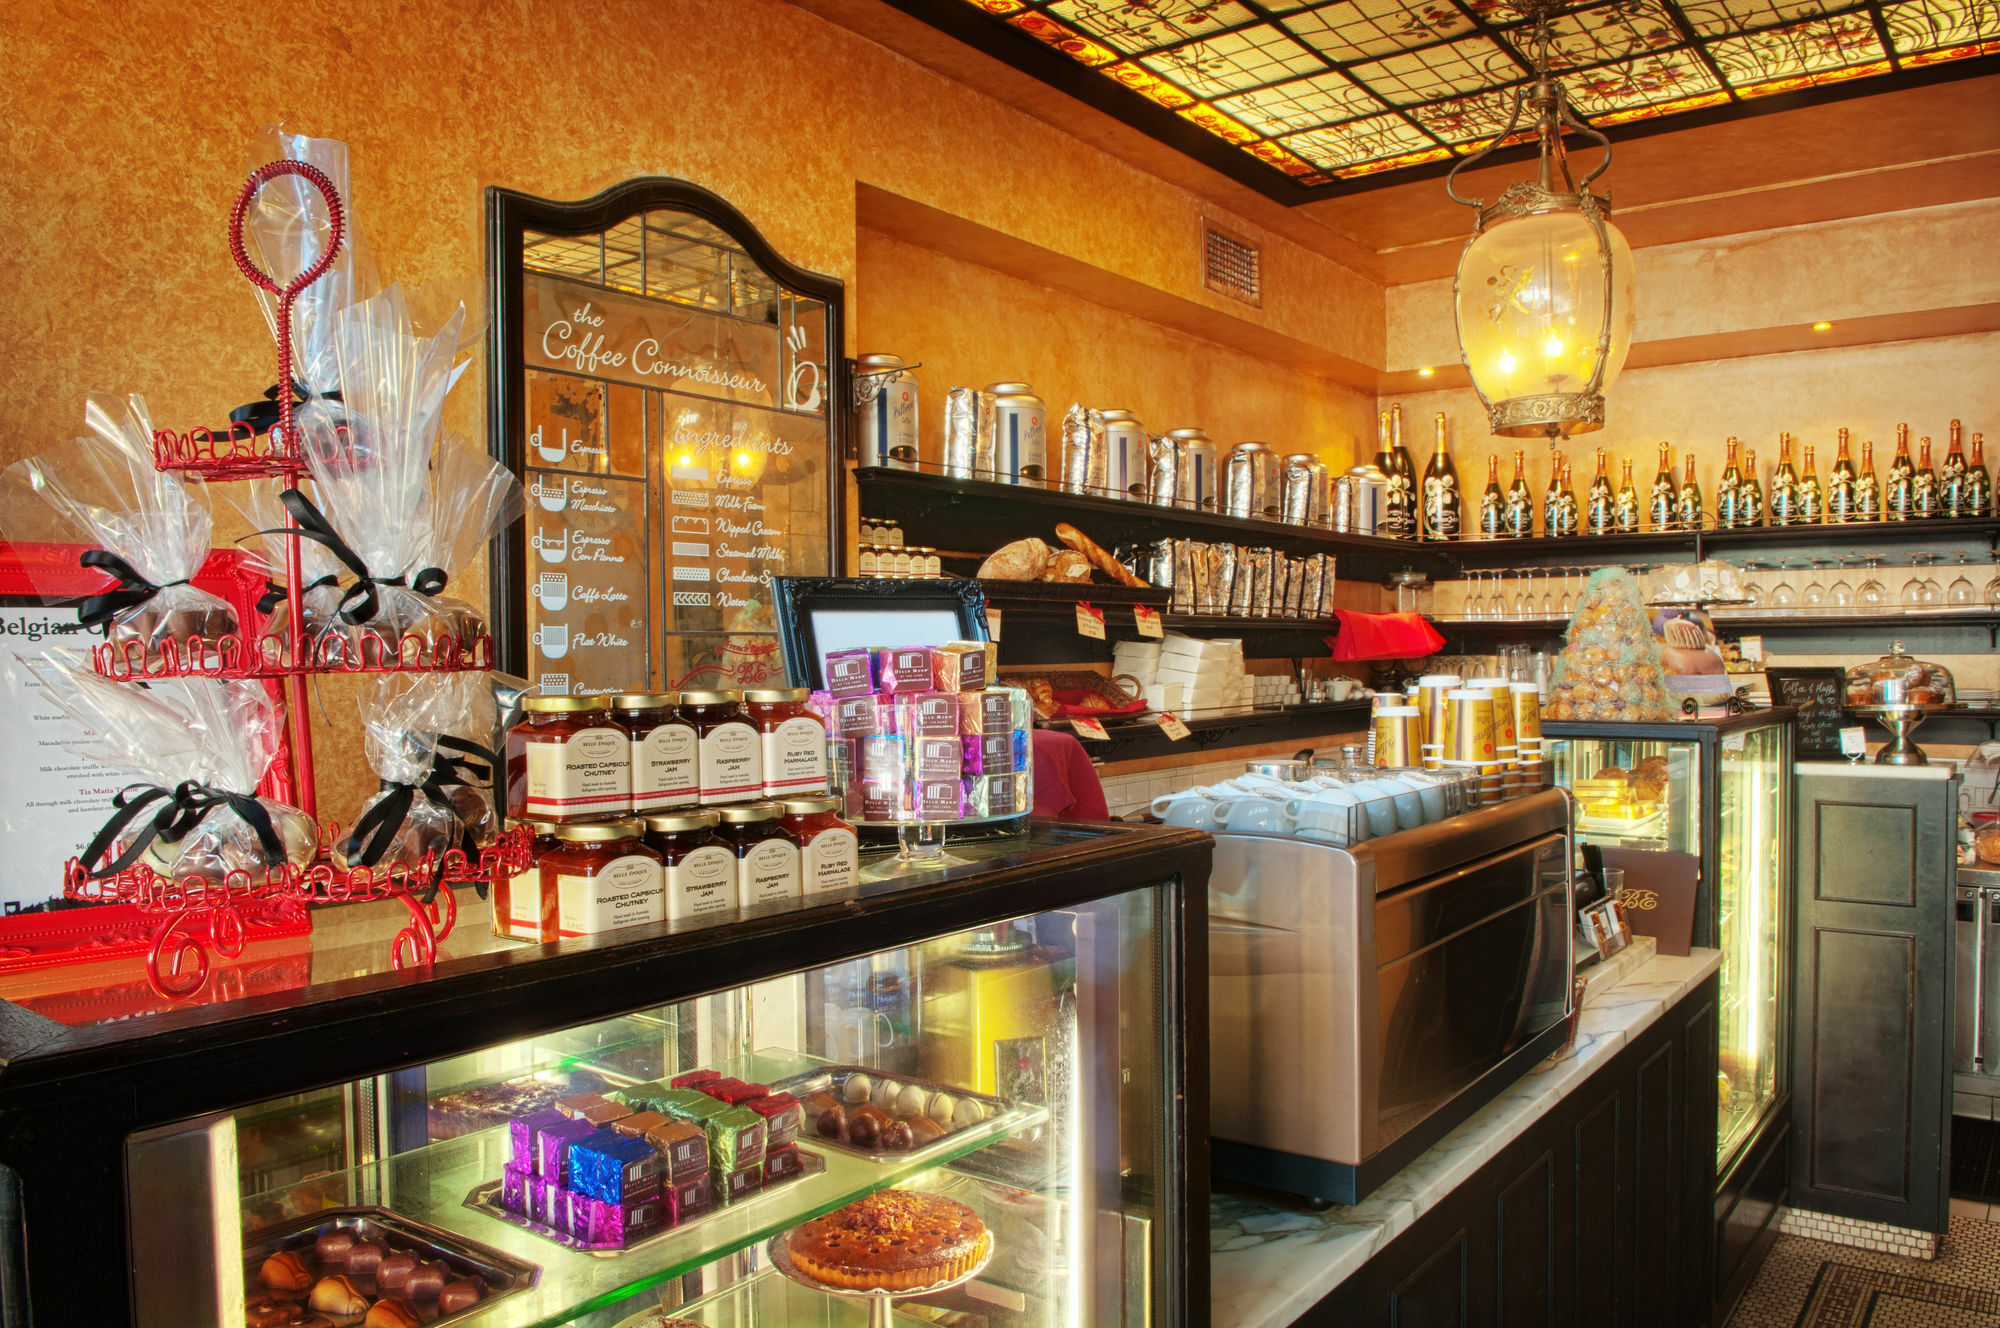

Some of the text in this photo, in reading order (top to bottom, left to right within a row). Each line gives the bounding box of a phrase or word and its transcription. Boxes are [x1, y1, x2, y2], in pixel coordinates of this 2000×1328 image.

[573, 302, 604, 327] the
[543, 320, 766, 392] Coffee Connoisseur
[674, 409, 793, 456] Ingredients
[571, 481, 608, 497] Espresso
[571, 500, 616, 513] Macchiato
[715, 494, 766, 512] Milk Foam
[716, 518, 781, 538] Wipped Cream
[571, 530, 611, 547] Espresso
[571, 547, 624, 562] Con Panna
[716, 543, 782, 561] Steamed Milk
[716, 567, 758, 583] Chocolate
[601, 586, 628, 602] Latte
[717, 592, 748, 607] Water
[572, 632, 629, 650] Flat White
[737, 661, 767, 684] BE
[566, 763, 597, 771] ROASTED
[651, 758, 691, 767] STRAWBERRY
[716, 757, 751, 765] RASPBERRY
[784, 756, 818, 764] MARMALADE
[584, 769, 616, 777] CHUTNEY
[755, 873, 790, 883] RASPBERRY
[818, 866, 851, 877] MARMALADE
[686, 880, 728, 892] STRAWBERRY
[596, 893, 629, 904] ROASTED
[615, 898, 649, 909] CHUTNEY
[1617, 888, 1659, 910] BE
